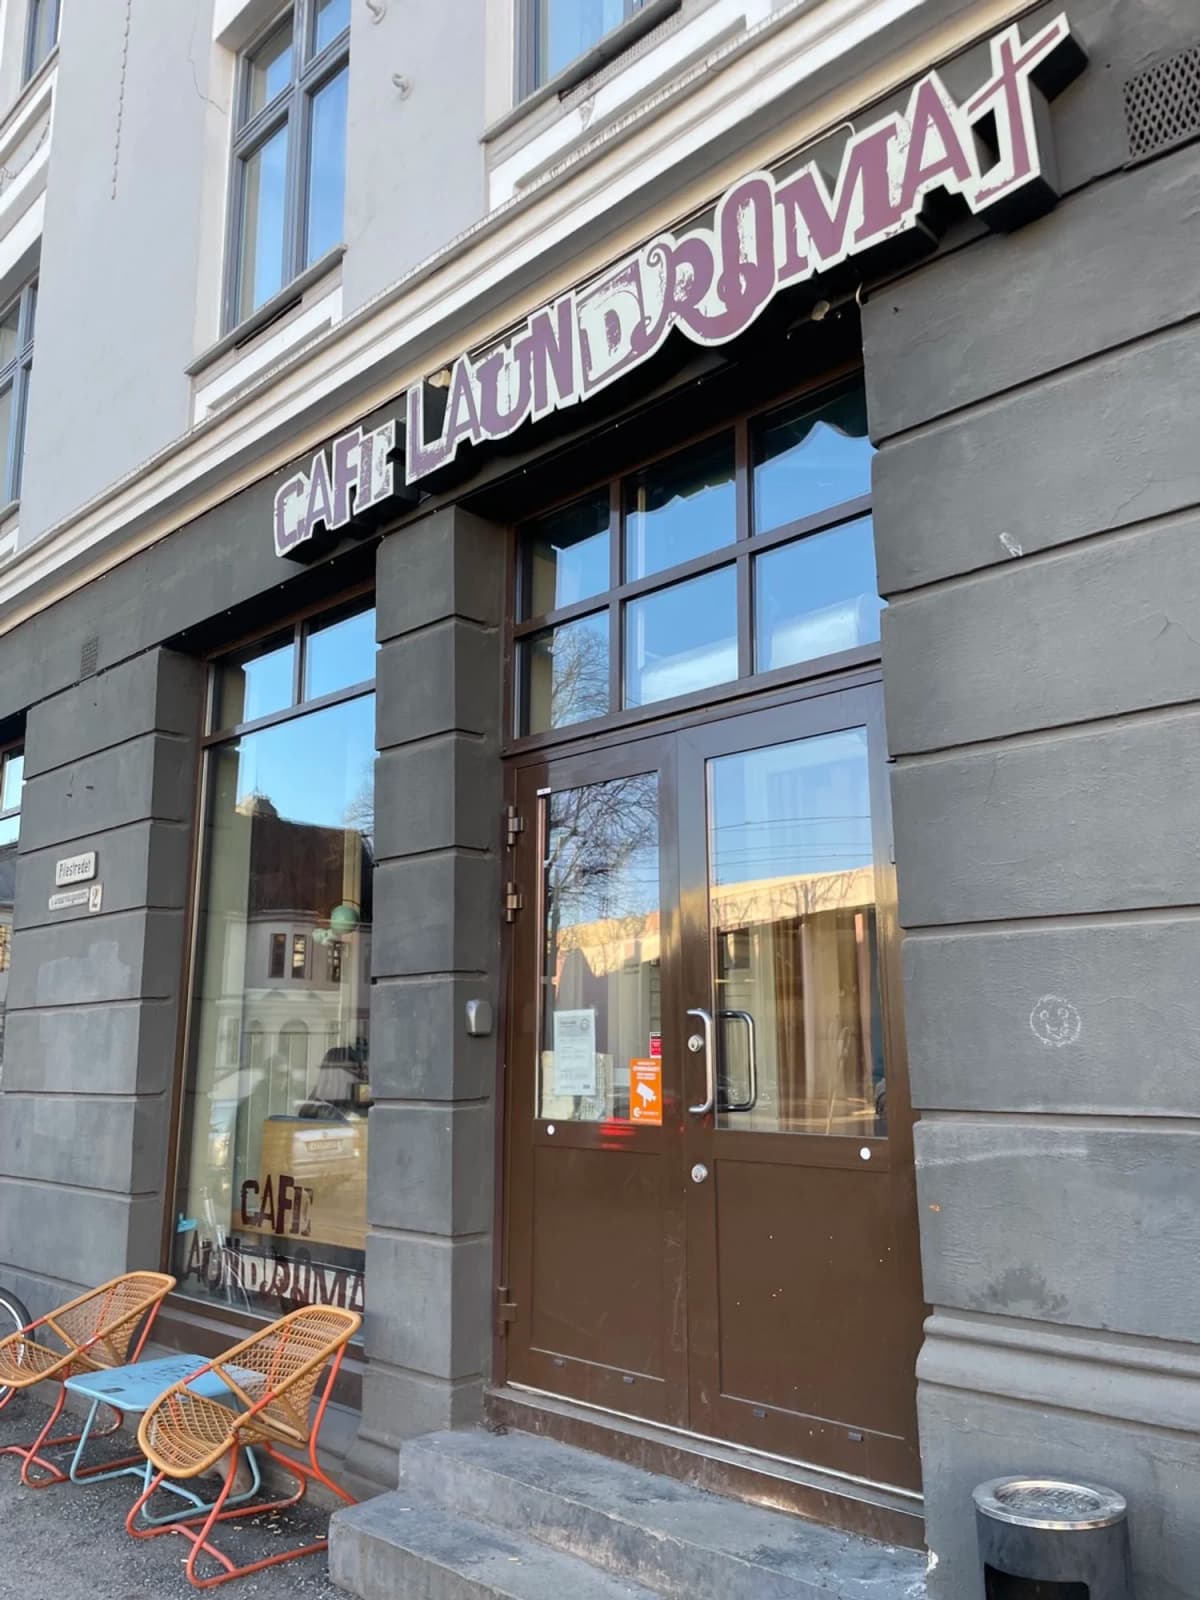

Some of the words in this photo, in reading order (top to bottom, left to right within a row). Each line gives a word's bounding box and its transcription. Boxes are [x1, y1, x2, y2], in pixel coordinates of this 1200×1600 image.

[275, 420, 395, 555] CAFE
[407, 14, 1069, 485] LAUNDROMAT
[240, 1174, 313, 1237] CAFE
